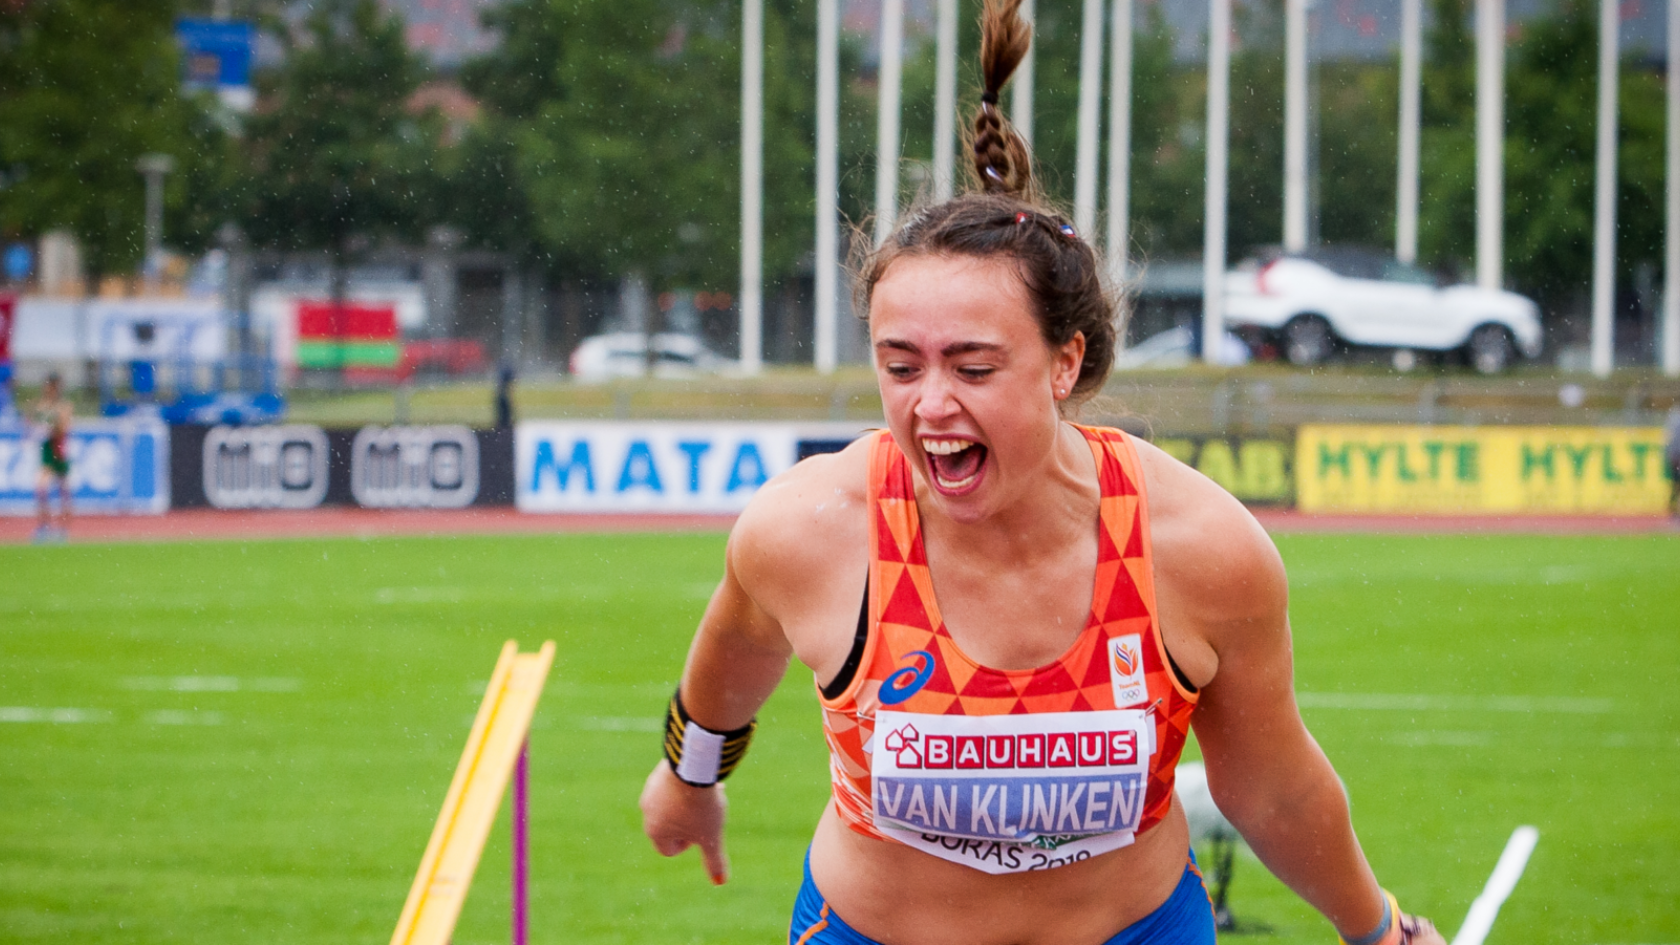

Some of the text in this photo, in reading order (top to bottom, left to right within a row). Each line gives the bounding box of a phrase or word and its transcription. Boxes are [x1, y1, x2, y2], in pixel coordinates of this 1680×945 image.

[531, 440, 767, 493] MATA
[1317, 440, 1480, 480] HYLTE
[926, 733, 1137, 766] BAUHAUS
[879, 778, 1138, 836] VAN KLINKEN
